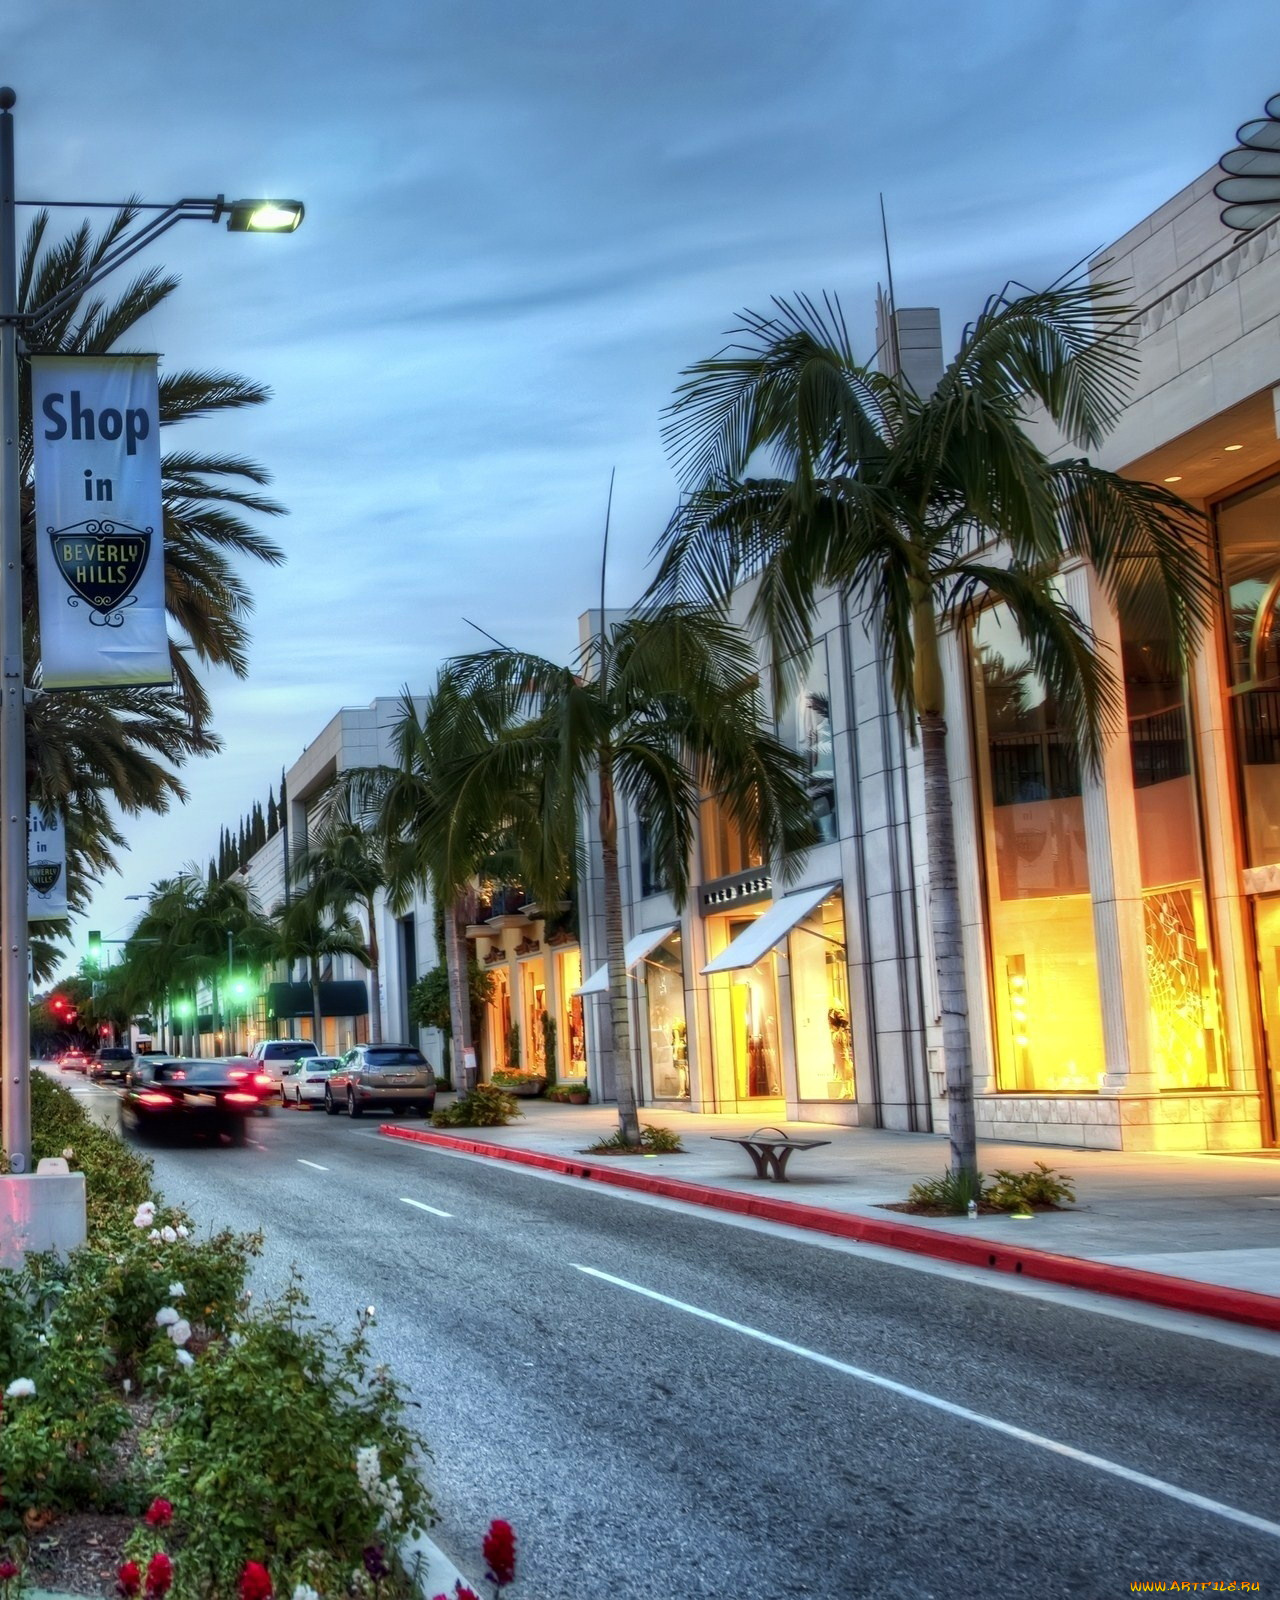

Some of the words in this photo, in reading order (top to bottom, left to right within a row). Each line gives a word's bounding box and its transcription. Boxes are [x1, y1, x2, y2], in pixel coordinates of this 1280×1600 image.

[42, 391, 150, 456] Shop
[84, 469, 113, 502] in
[63, 544, 138, 563] BEVERLY
[75, 565, 127, 584] HILLS
[36, 841, 47, 852] in
[29, 868, 57, 876] BEVERLY
[33, 876, 53, 884] HILLS
[704, 886, 737, 905] HUGO
[738, 876, 773, 897] BOSS
